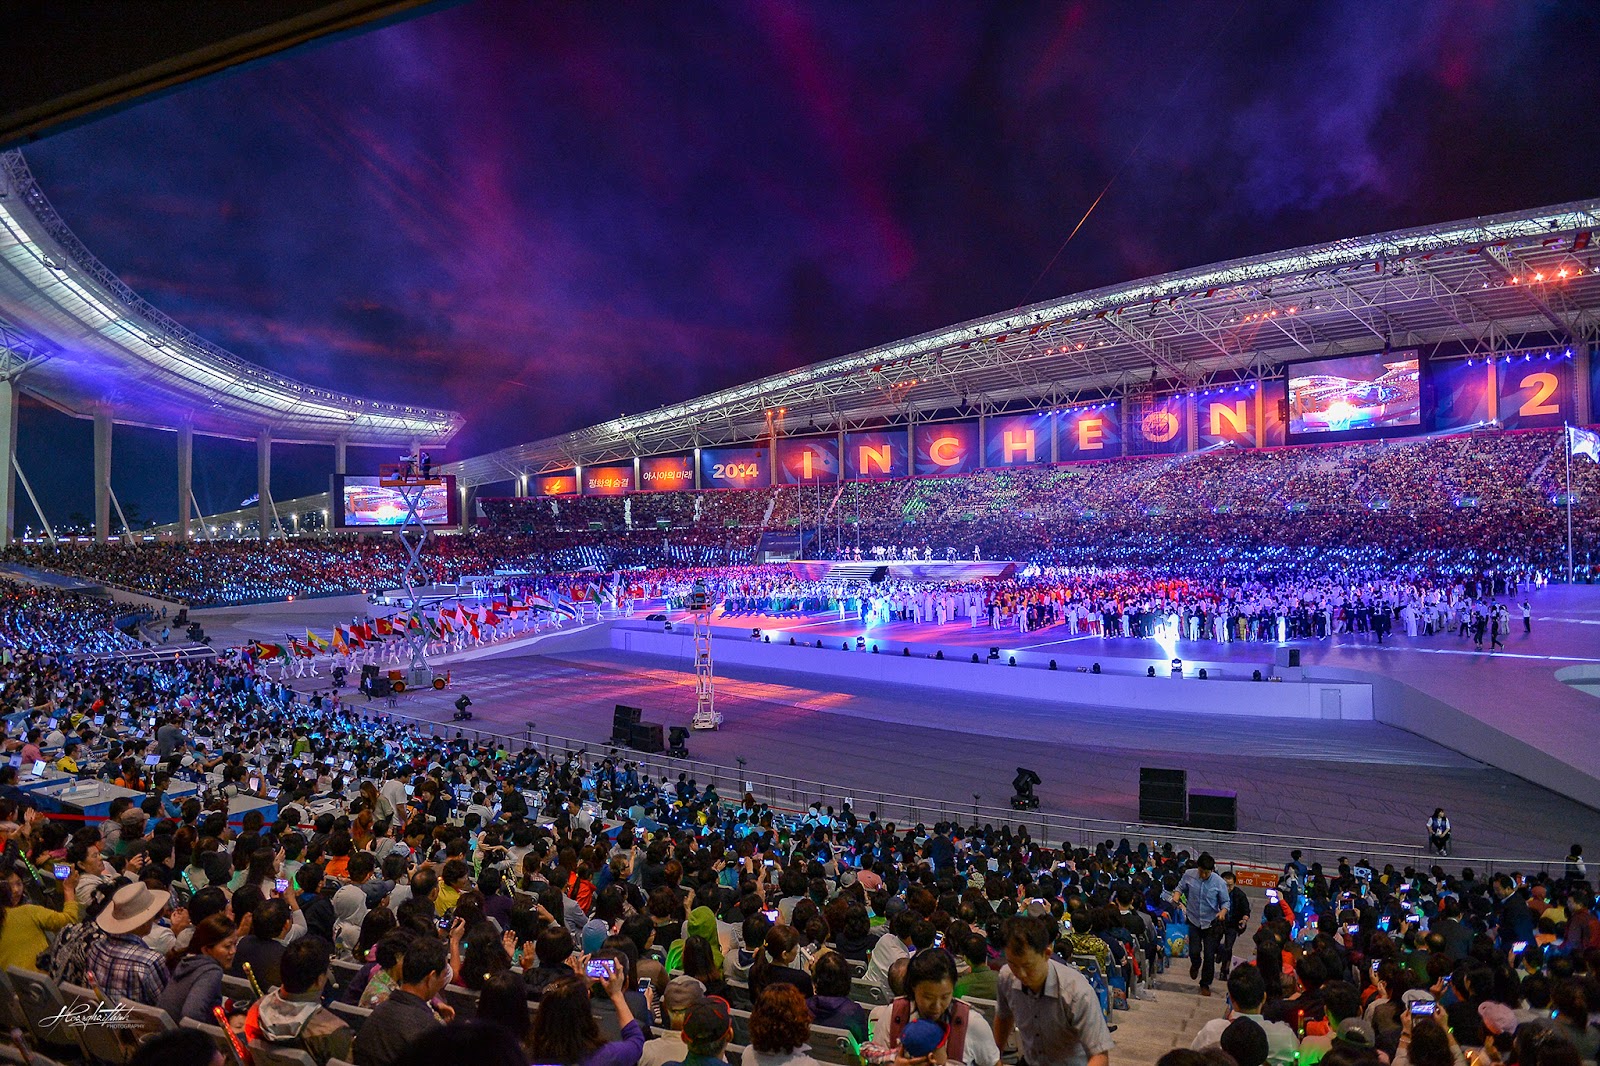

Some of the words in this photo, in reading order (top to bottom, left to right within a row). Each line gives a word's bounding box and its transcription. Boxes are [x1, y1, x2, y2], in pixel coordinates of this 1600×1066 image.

[643, 470, 675, 481] 아시아의
[675, 470, 693, 480] 미래
[712, 463, 759, 479] 2014
[588, 478, 612, 489] 평화의
